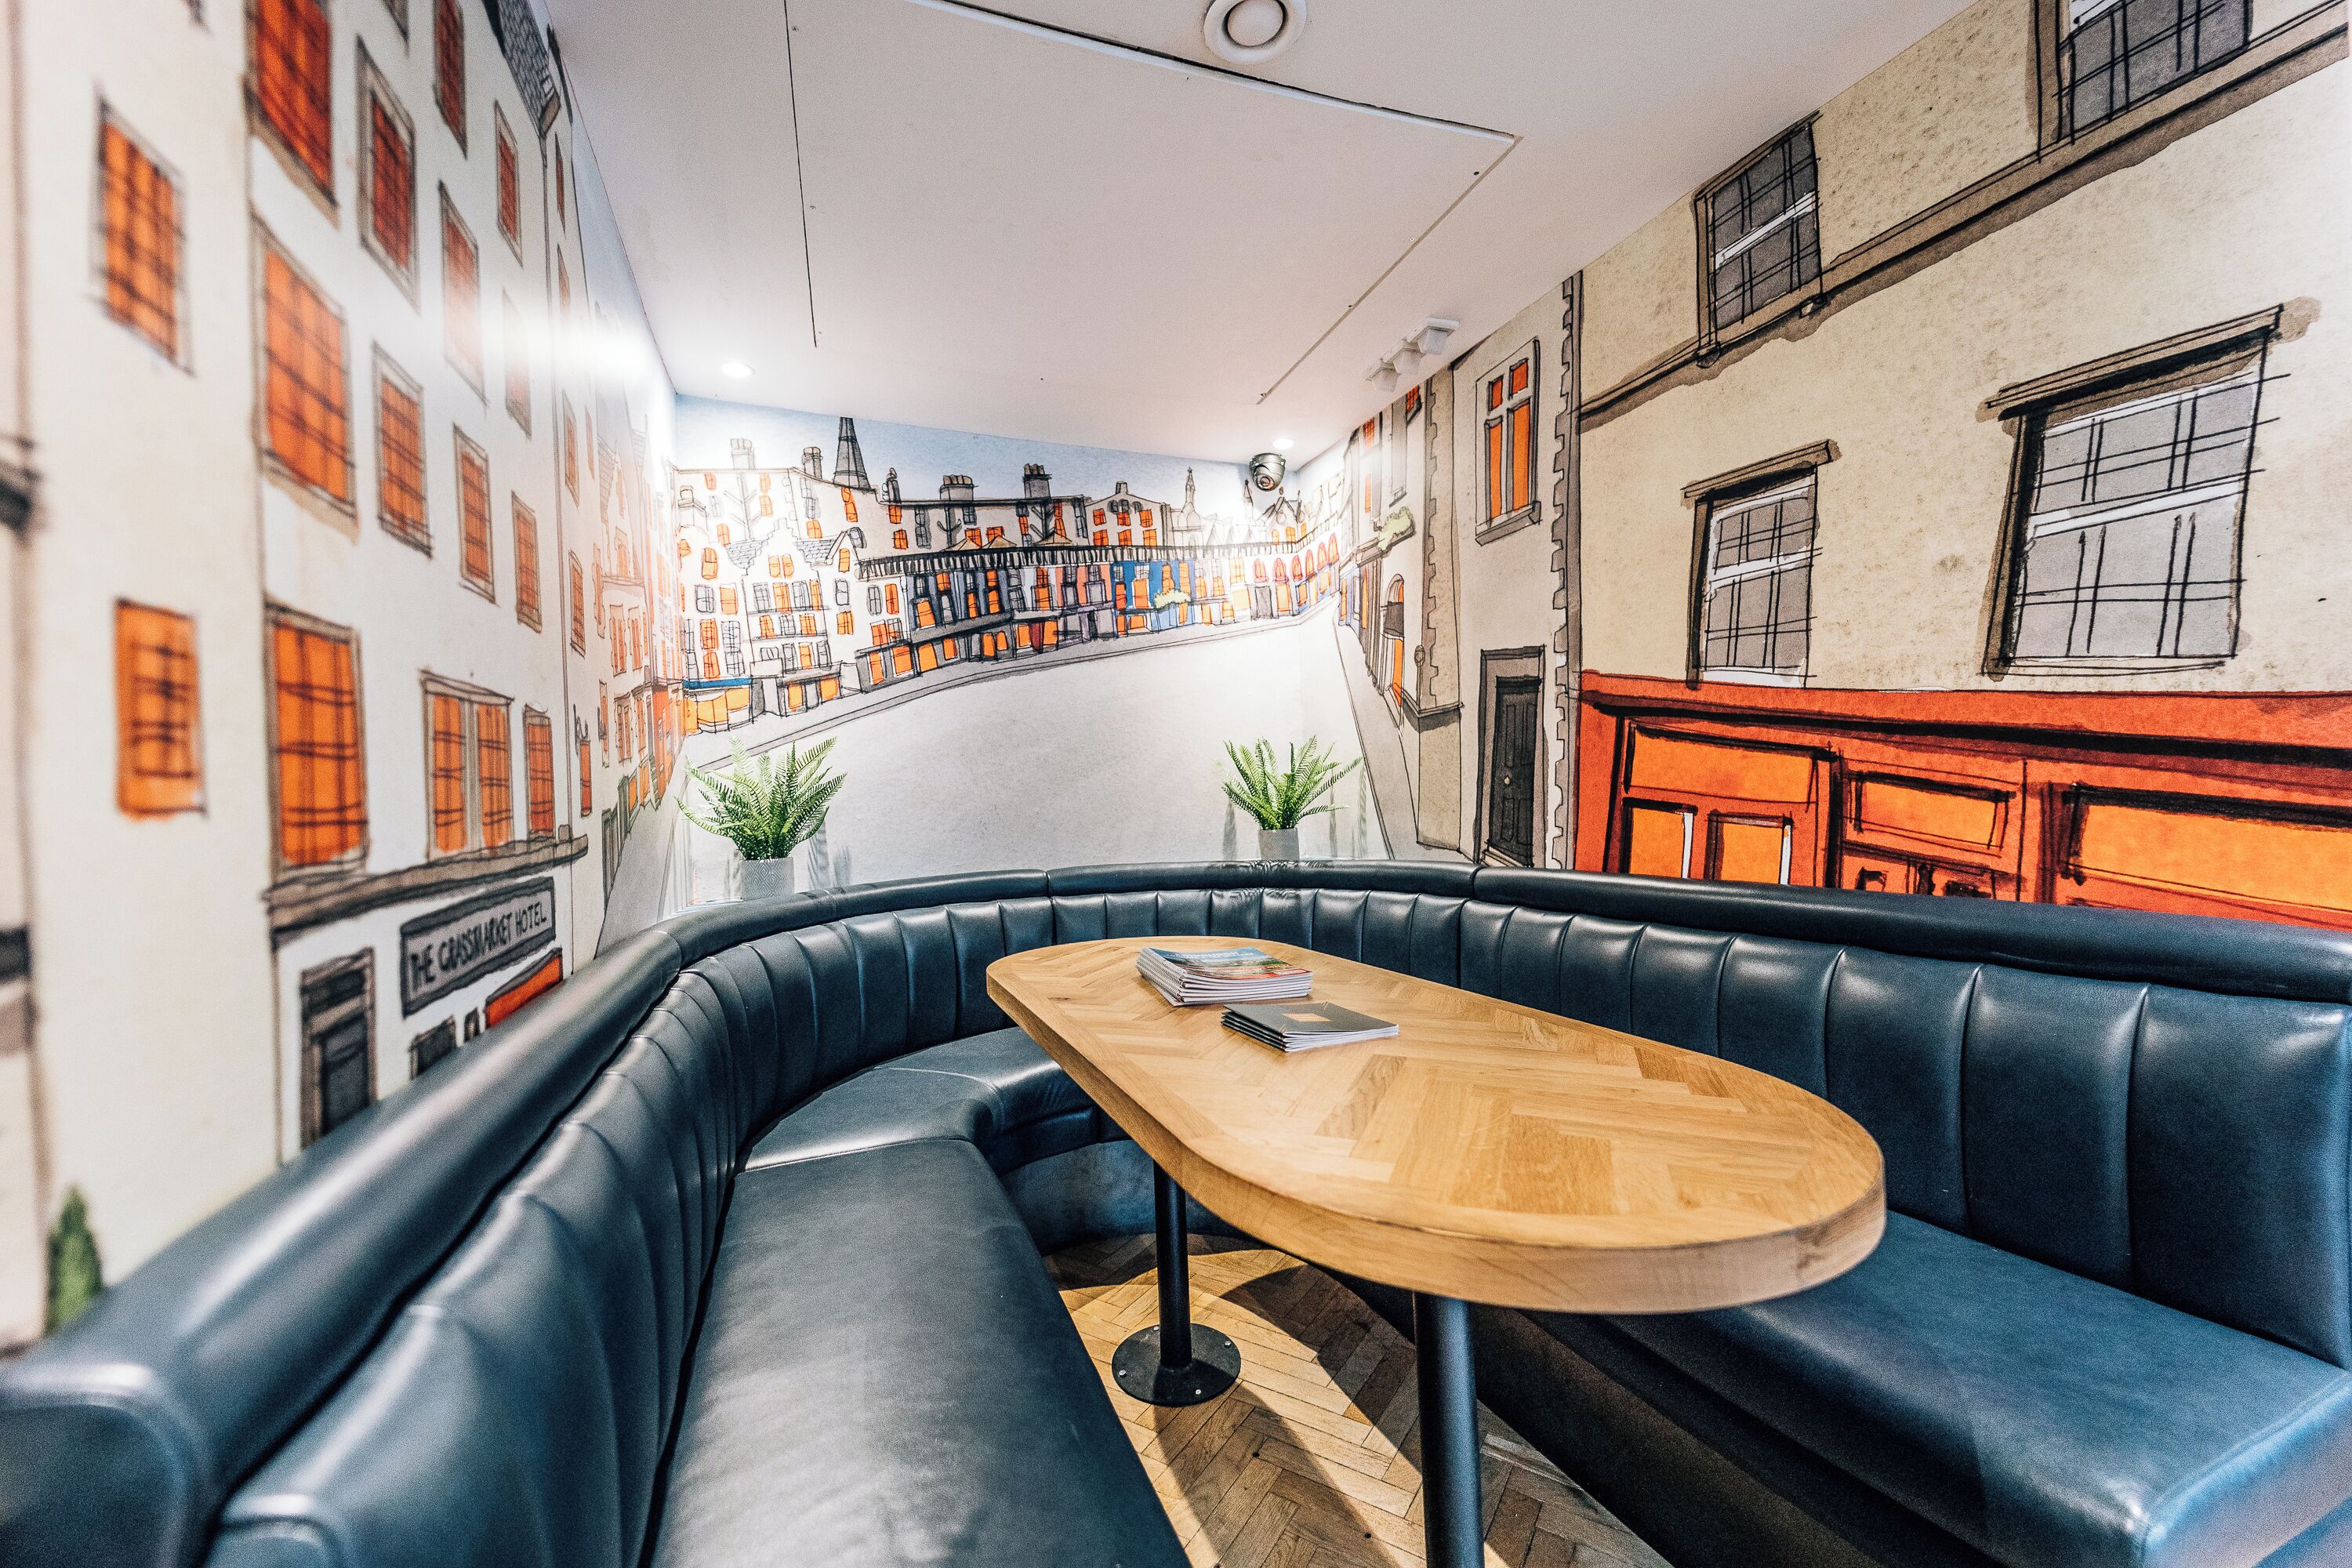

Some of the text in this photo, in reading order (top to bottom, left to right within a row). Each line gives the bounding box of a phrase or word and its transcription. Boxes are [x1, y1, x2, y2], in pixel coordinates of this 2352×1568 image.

[410, 902, 547, 991] THE GRASSMARKET HOTEL
